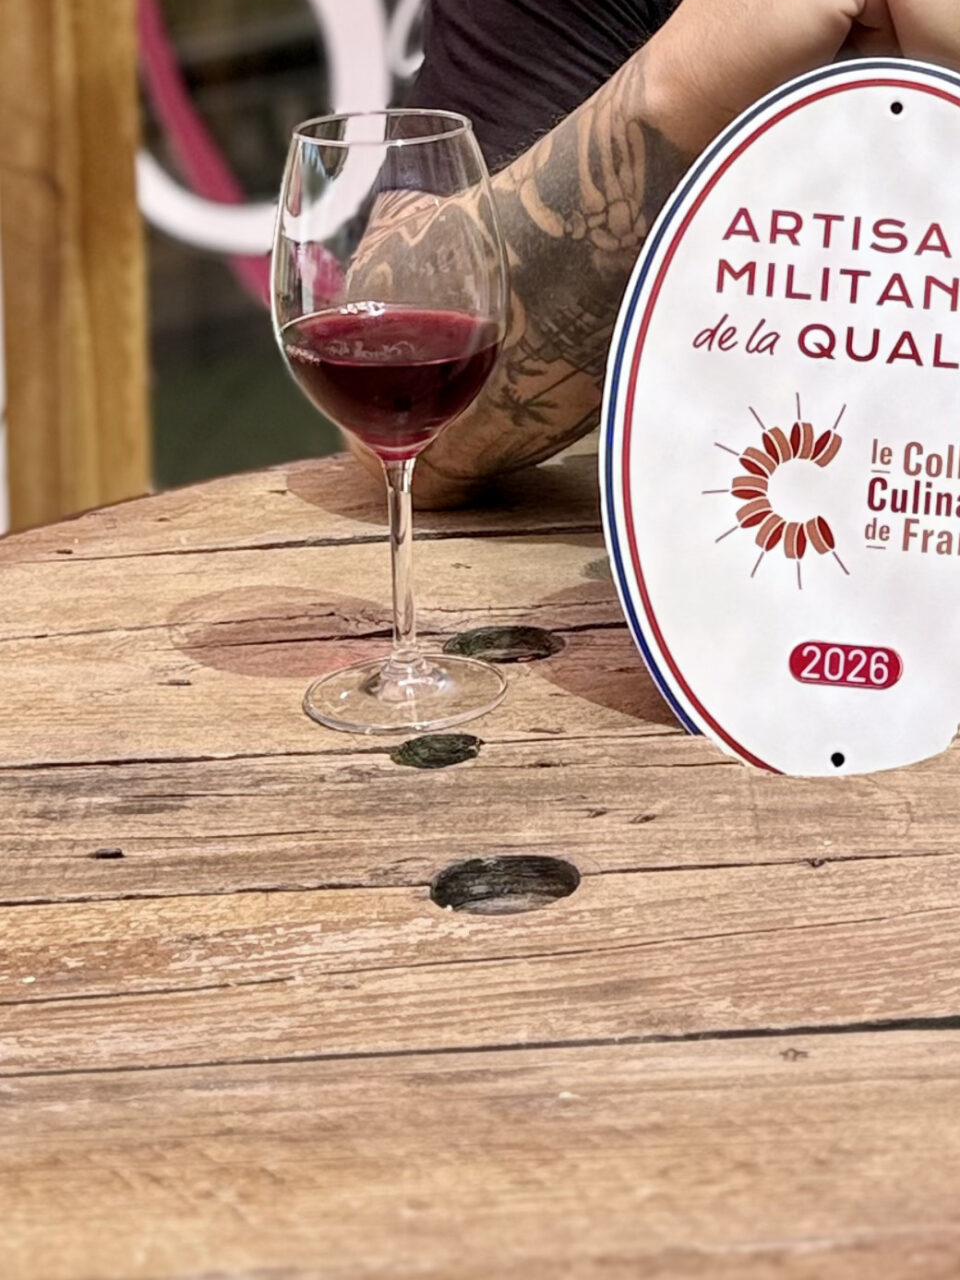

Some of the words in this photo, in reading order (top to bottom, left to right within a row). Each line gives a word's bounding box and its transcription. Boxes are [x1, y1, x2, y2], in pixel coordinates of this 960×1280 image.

[692, 313, 739, 352] de
[745, 318, 781, 356] la
[871, 438, 893, 466] le
[864, 517, 891, 542] de
[800, 645, 890, 685] 2026
